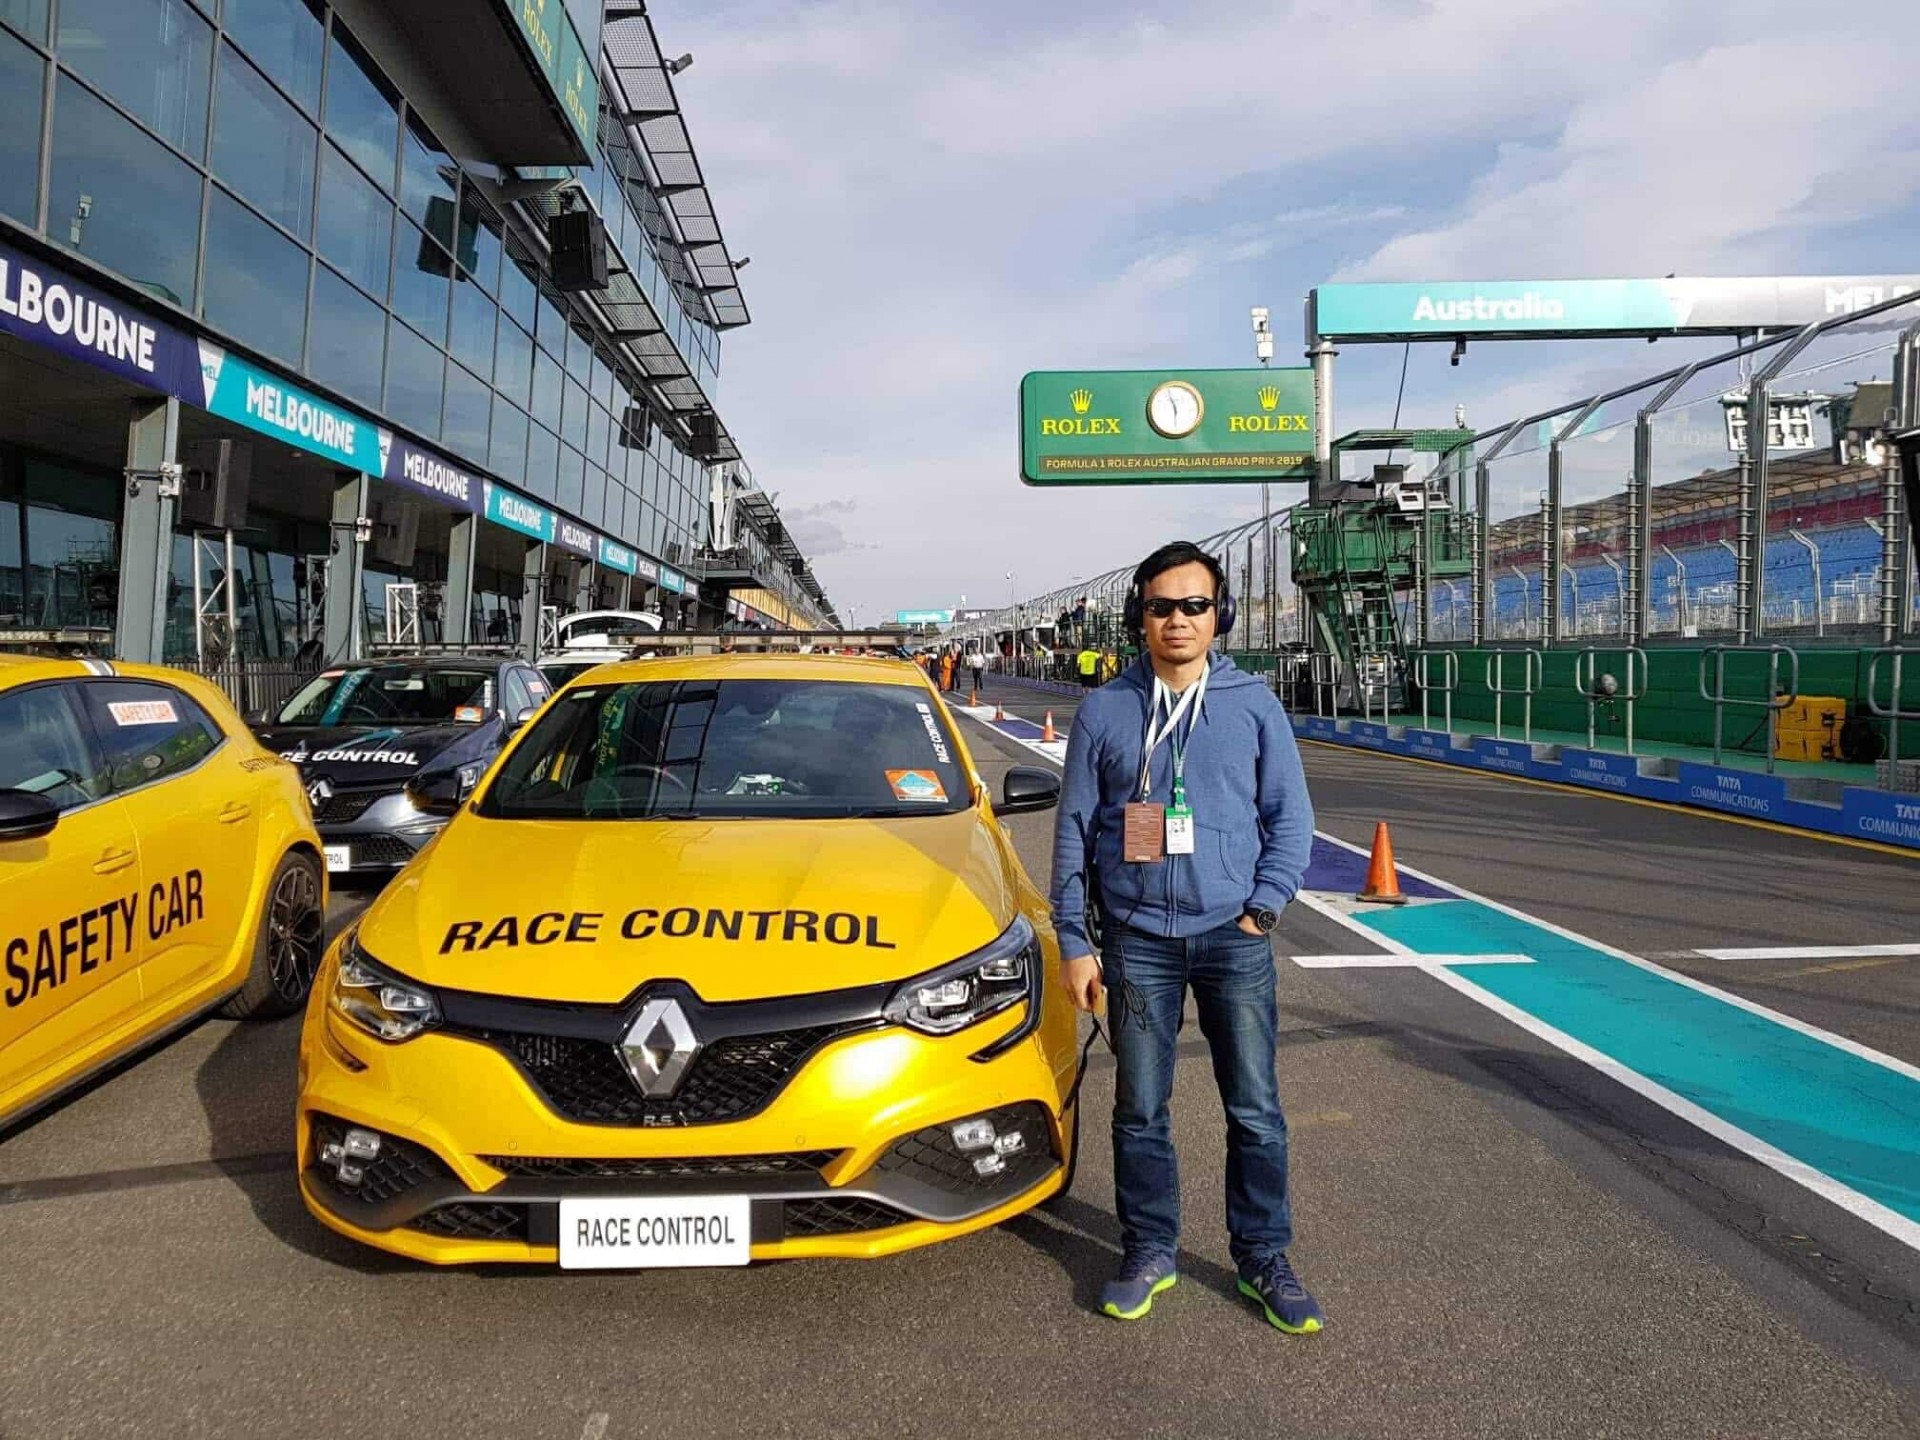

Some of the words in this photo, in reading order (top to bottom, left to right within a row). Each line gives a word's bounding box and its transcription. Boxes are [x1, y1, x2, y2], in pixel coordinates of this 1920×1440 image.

[1413, 291, 1564, 321] Australia
[246, 376, 355, 455] MELBOURNE
[1042, 418, 1121, 435] ROLEX
[1229, 414, 1309, 432] ROLEX
[404, 450, 469, 501] MELBOURNE
[1046, 459, 1098, 469] FORMULA
[1100, 459, 1105, 468] 1
[1108, 459, 1141, 468] ROLEX
[1144, 457, 1209, 468] AUSTRALIAN
[1212, 457, 1250, 466] GRAND
[1252, 456, 1275, 465] PRIX
[1277, 456, 1303, 465] 2019
[499, 494, 541, 531] MELBOURNE
[562, 522, 592, 552] MELBOURNE
[311, 751, 419, 766] CONTROL
[1589, 757, 1607, 771] TATA
[1570, 767, 1627, 788] COMMUNICATIONS
[1716, 775, 1741, 790] TATA
[1691, 785, 1769, 813] COMMUNICATIONS
[5, 893, 138, 1008] SAFETY
[148, 869, 203, 941] CAR
[438, 912, 604, 955] RACE
[620, 907, 897, 950] CONTROL
[577, 1218, 631, 1247] RACE
[637, 1216, 735, 1245] CONTROL
